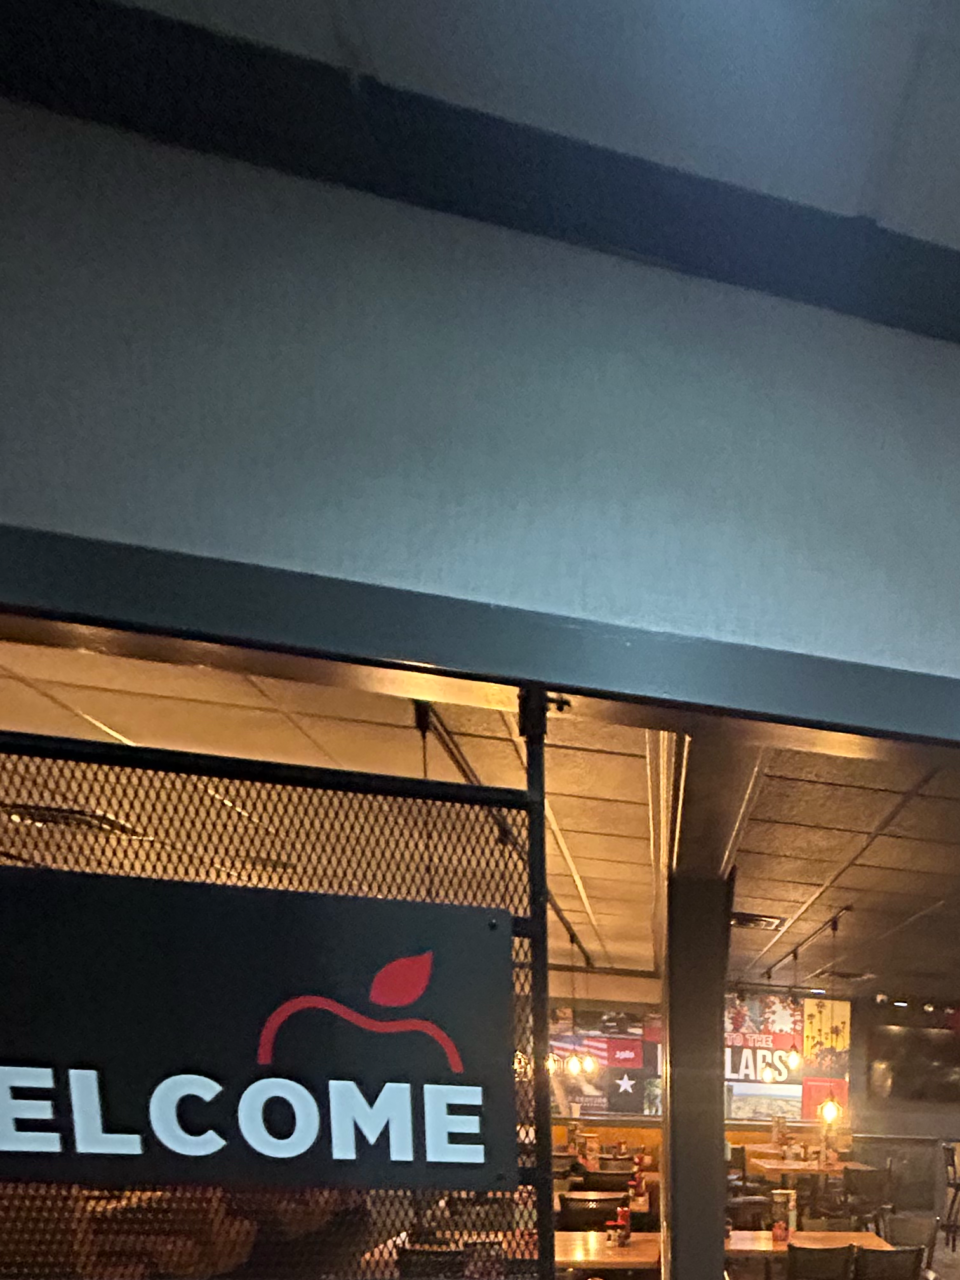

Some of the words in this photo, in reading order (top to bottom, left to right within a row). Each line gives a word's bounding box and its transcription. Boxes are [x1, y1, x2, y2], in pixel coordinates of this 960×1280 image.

[724, 1032, 744, 1046] TO
[745, 1034, 773, 1048] THE
[0, 1066, 485, 1163] ELCOME
